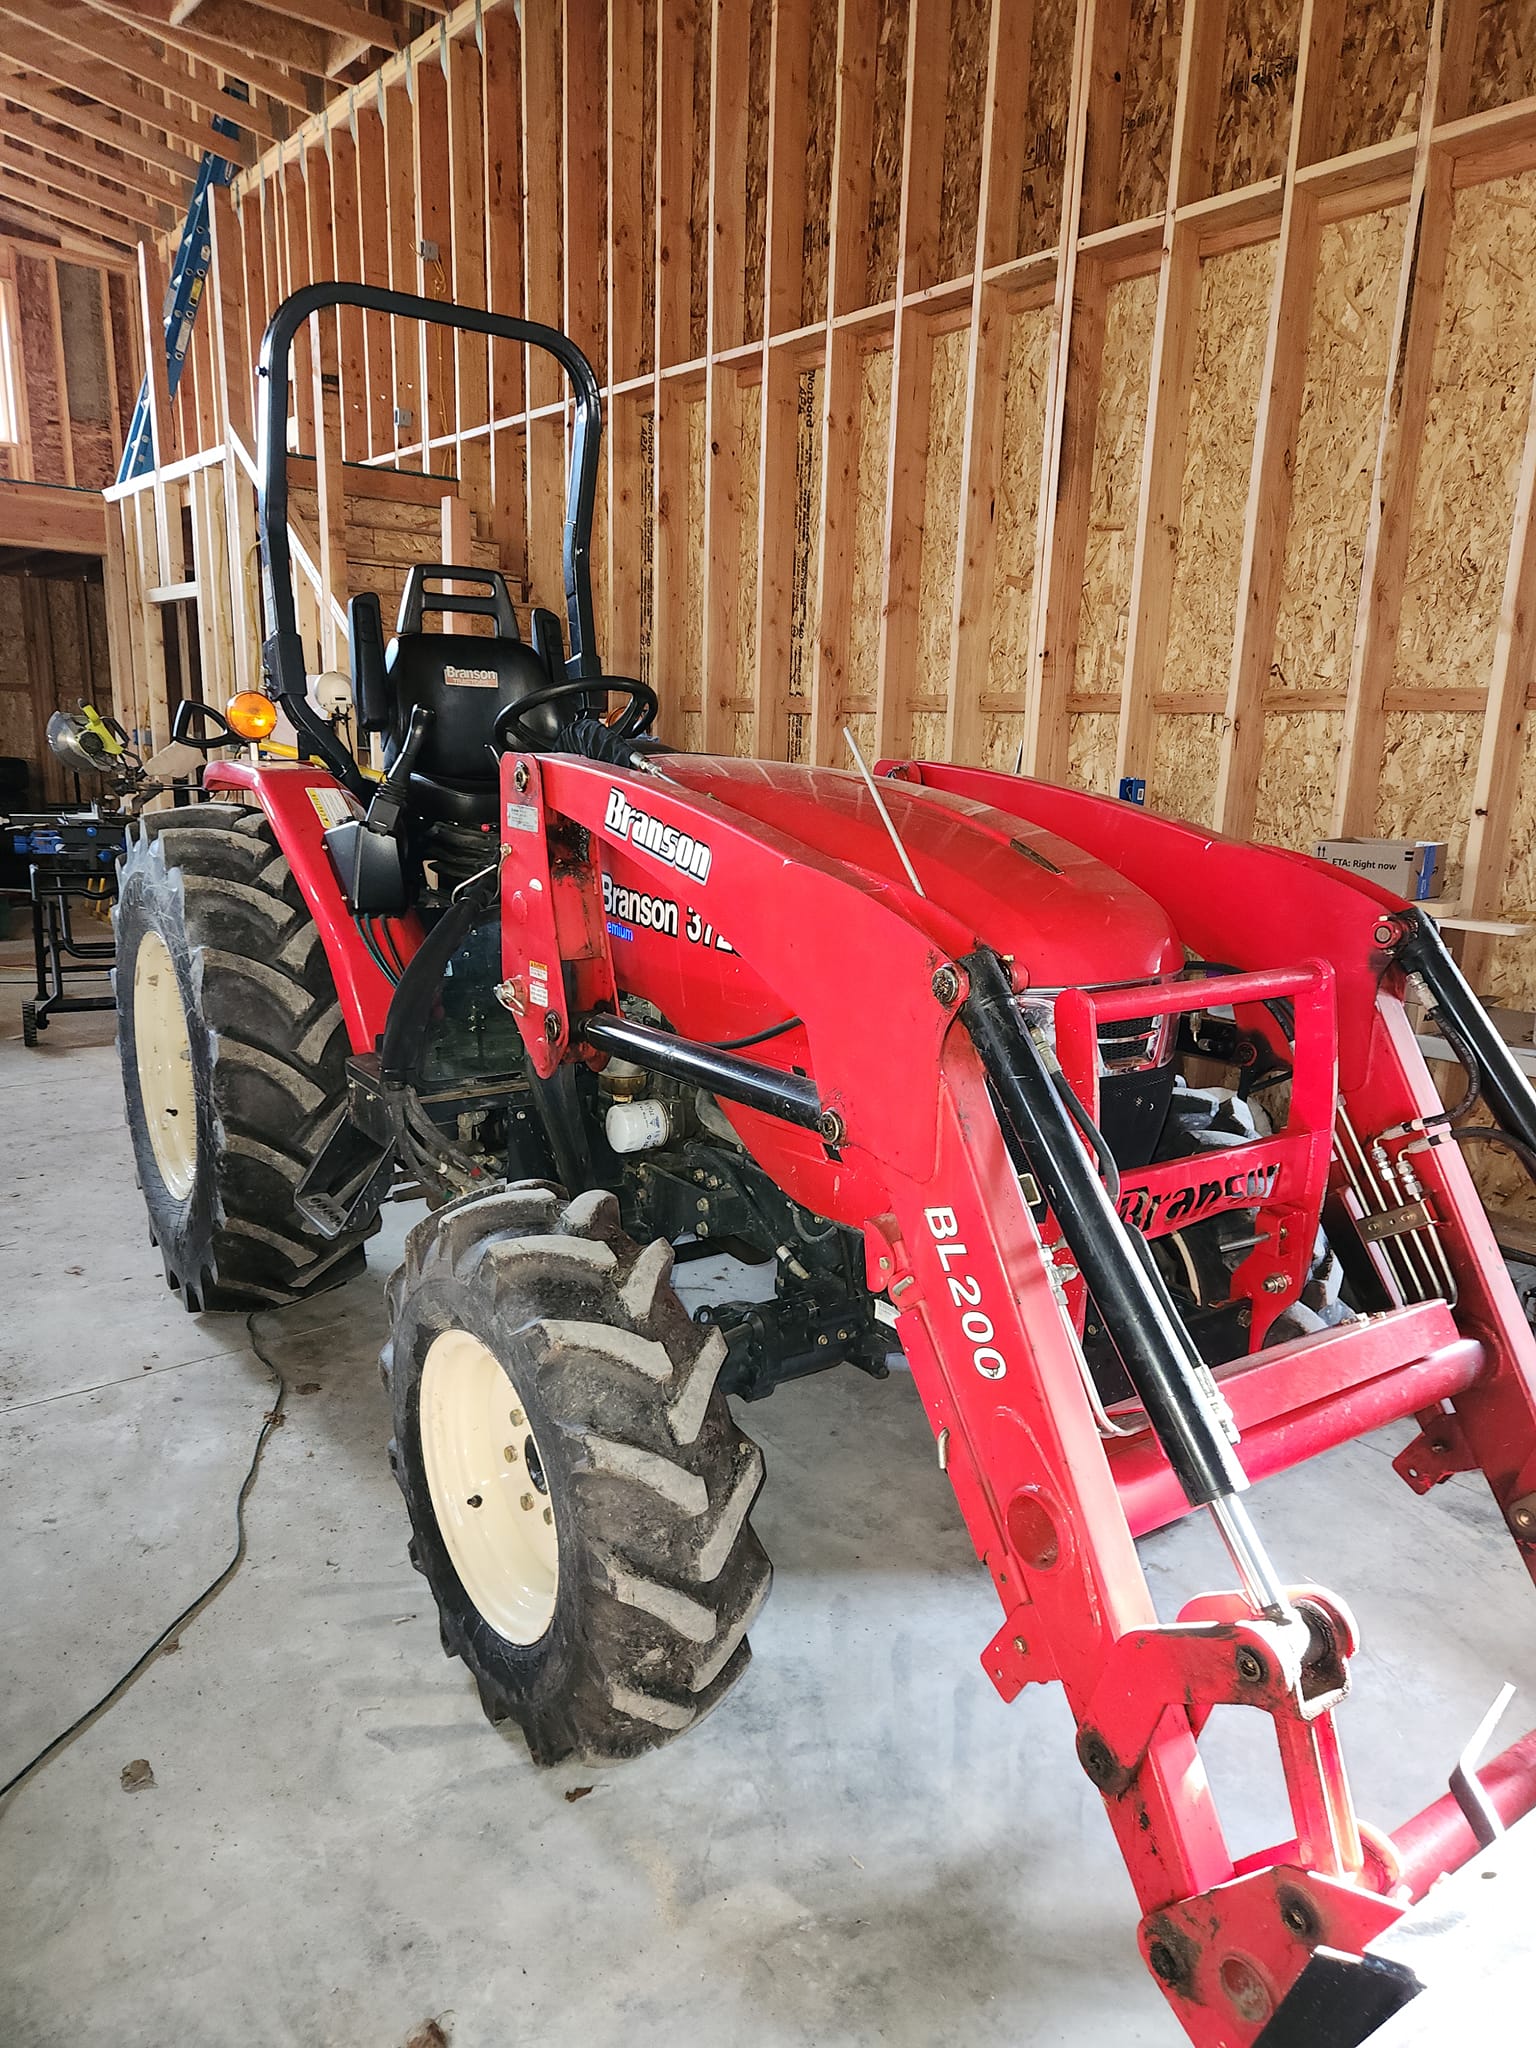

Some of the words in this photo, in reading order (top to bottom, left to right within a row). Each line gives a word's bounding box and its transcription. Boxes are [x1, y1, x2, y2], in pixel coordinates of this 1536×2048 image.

[446, 666, 497, 680] Branson
[604, 786, 713, 886] Branson
[1332, 858, 1351, 868] ETA:
[1353, 859, 1376, 870] Right
[1378, 862, 1397, 871] now
[601, 872, 678, 938] Branson
[924, 1206, 1008, 1381] BL200
